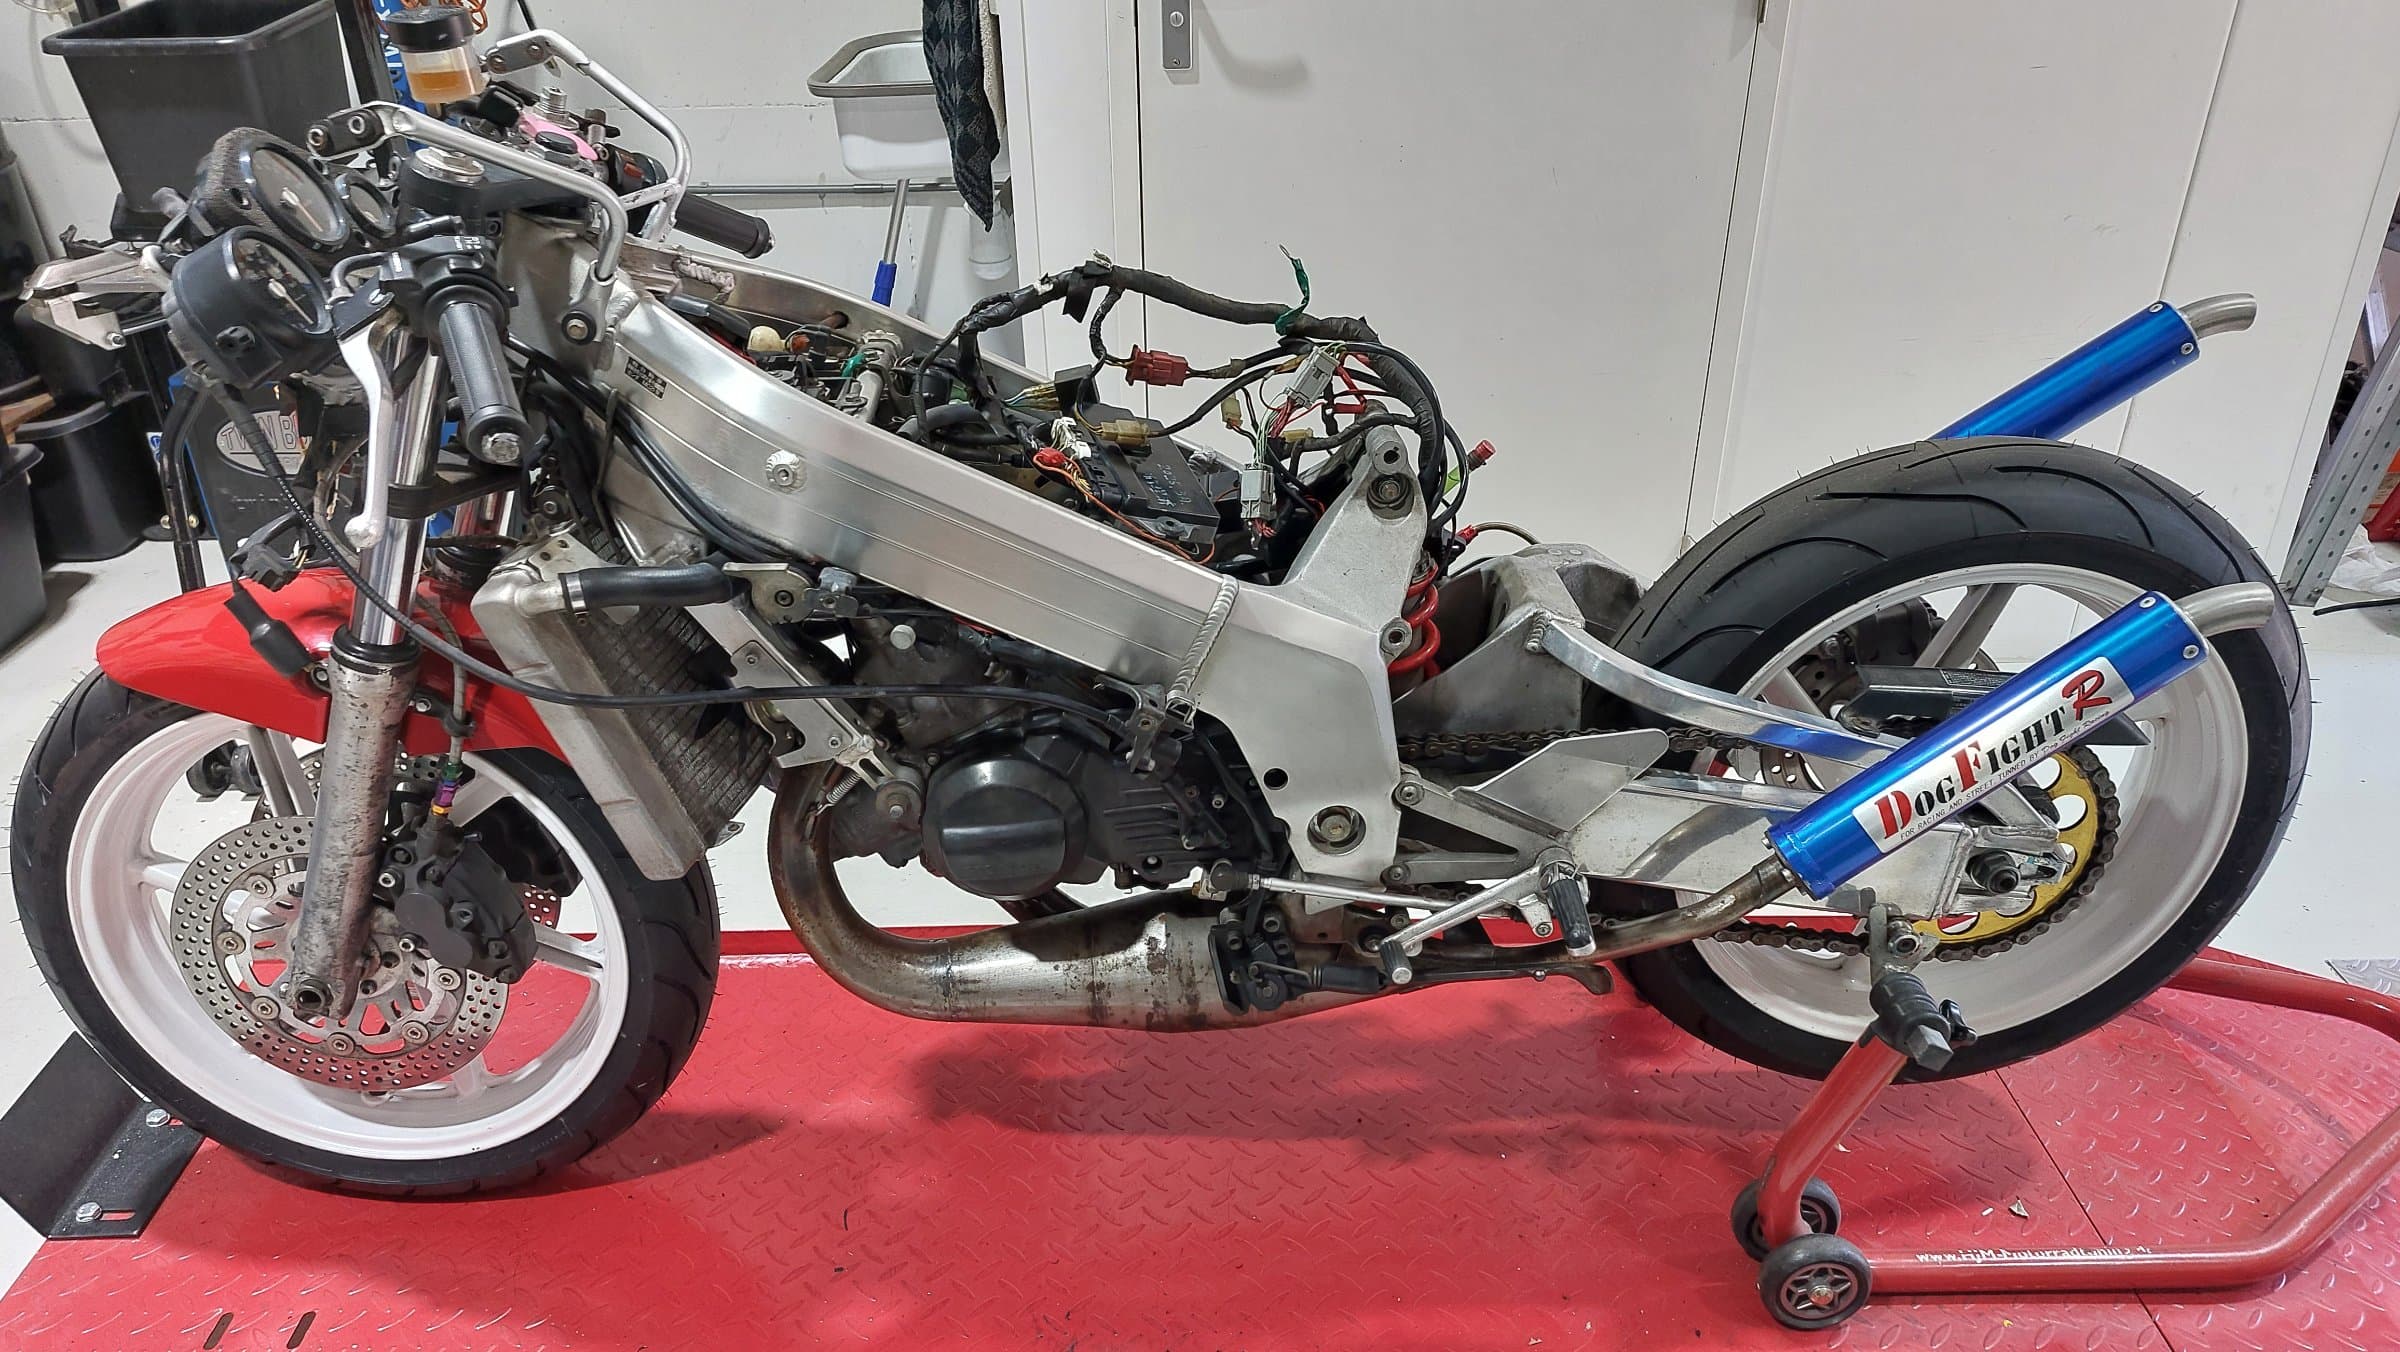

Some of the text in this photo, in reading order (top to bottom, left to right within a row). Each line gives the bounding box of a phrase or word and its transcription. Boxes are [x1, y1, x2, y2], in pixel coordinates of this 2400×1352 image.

[1900, 828, 1917, 842] FOR
[1917, 808, 1946, 832] RACING
[1948, 799, 1964, 812] AND
[1966, 780, 1995, 801] STREET
[1998, 759, 2027, 781] TUNNED
[2029, 750, 2040, 761] BY
